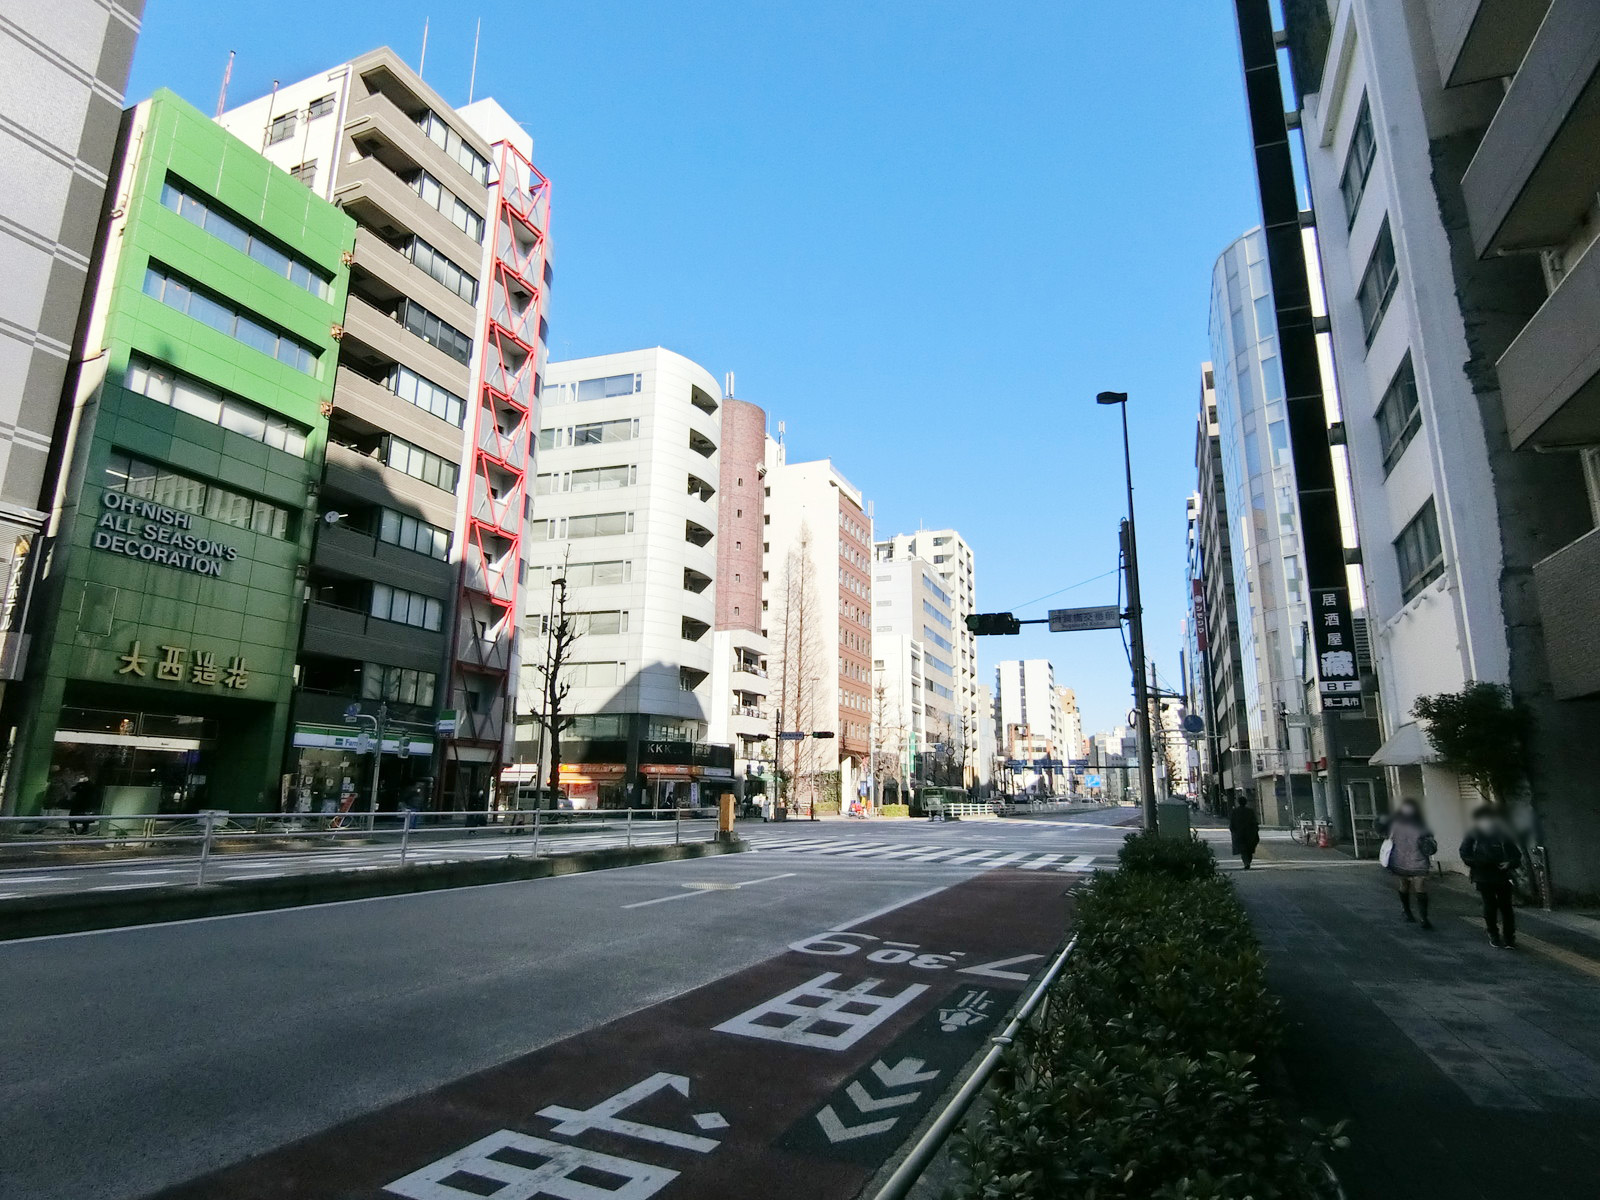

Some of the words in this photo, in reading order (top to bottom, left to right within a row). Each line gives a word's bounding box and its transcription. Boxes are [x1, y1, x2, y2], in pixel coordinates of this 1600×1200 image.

[104, 493, 192, 529] OH-NISHI
[95, 532, 222, 577] DECORATION
[100, 512, 137, 537] ALL
[143, 525, 238, 561] SEASON'S
[0, 557, 26, 631] アパホテル
[1322, 593, 1343, 646] 居酒屋
[119, 640, 249, 690] 大西造花
